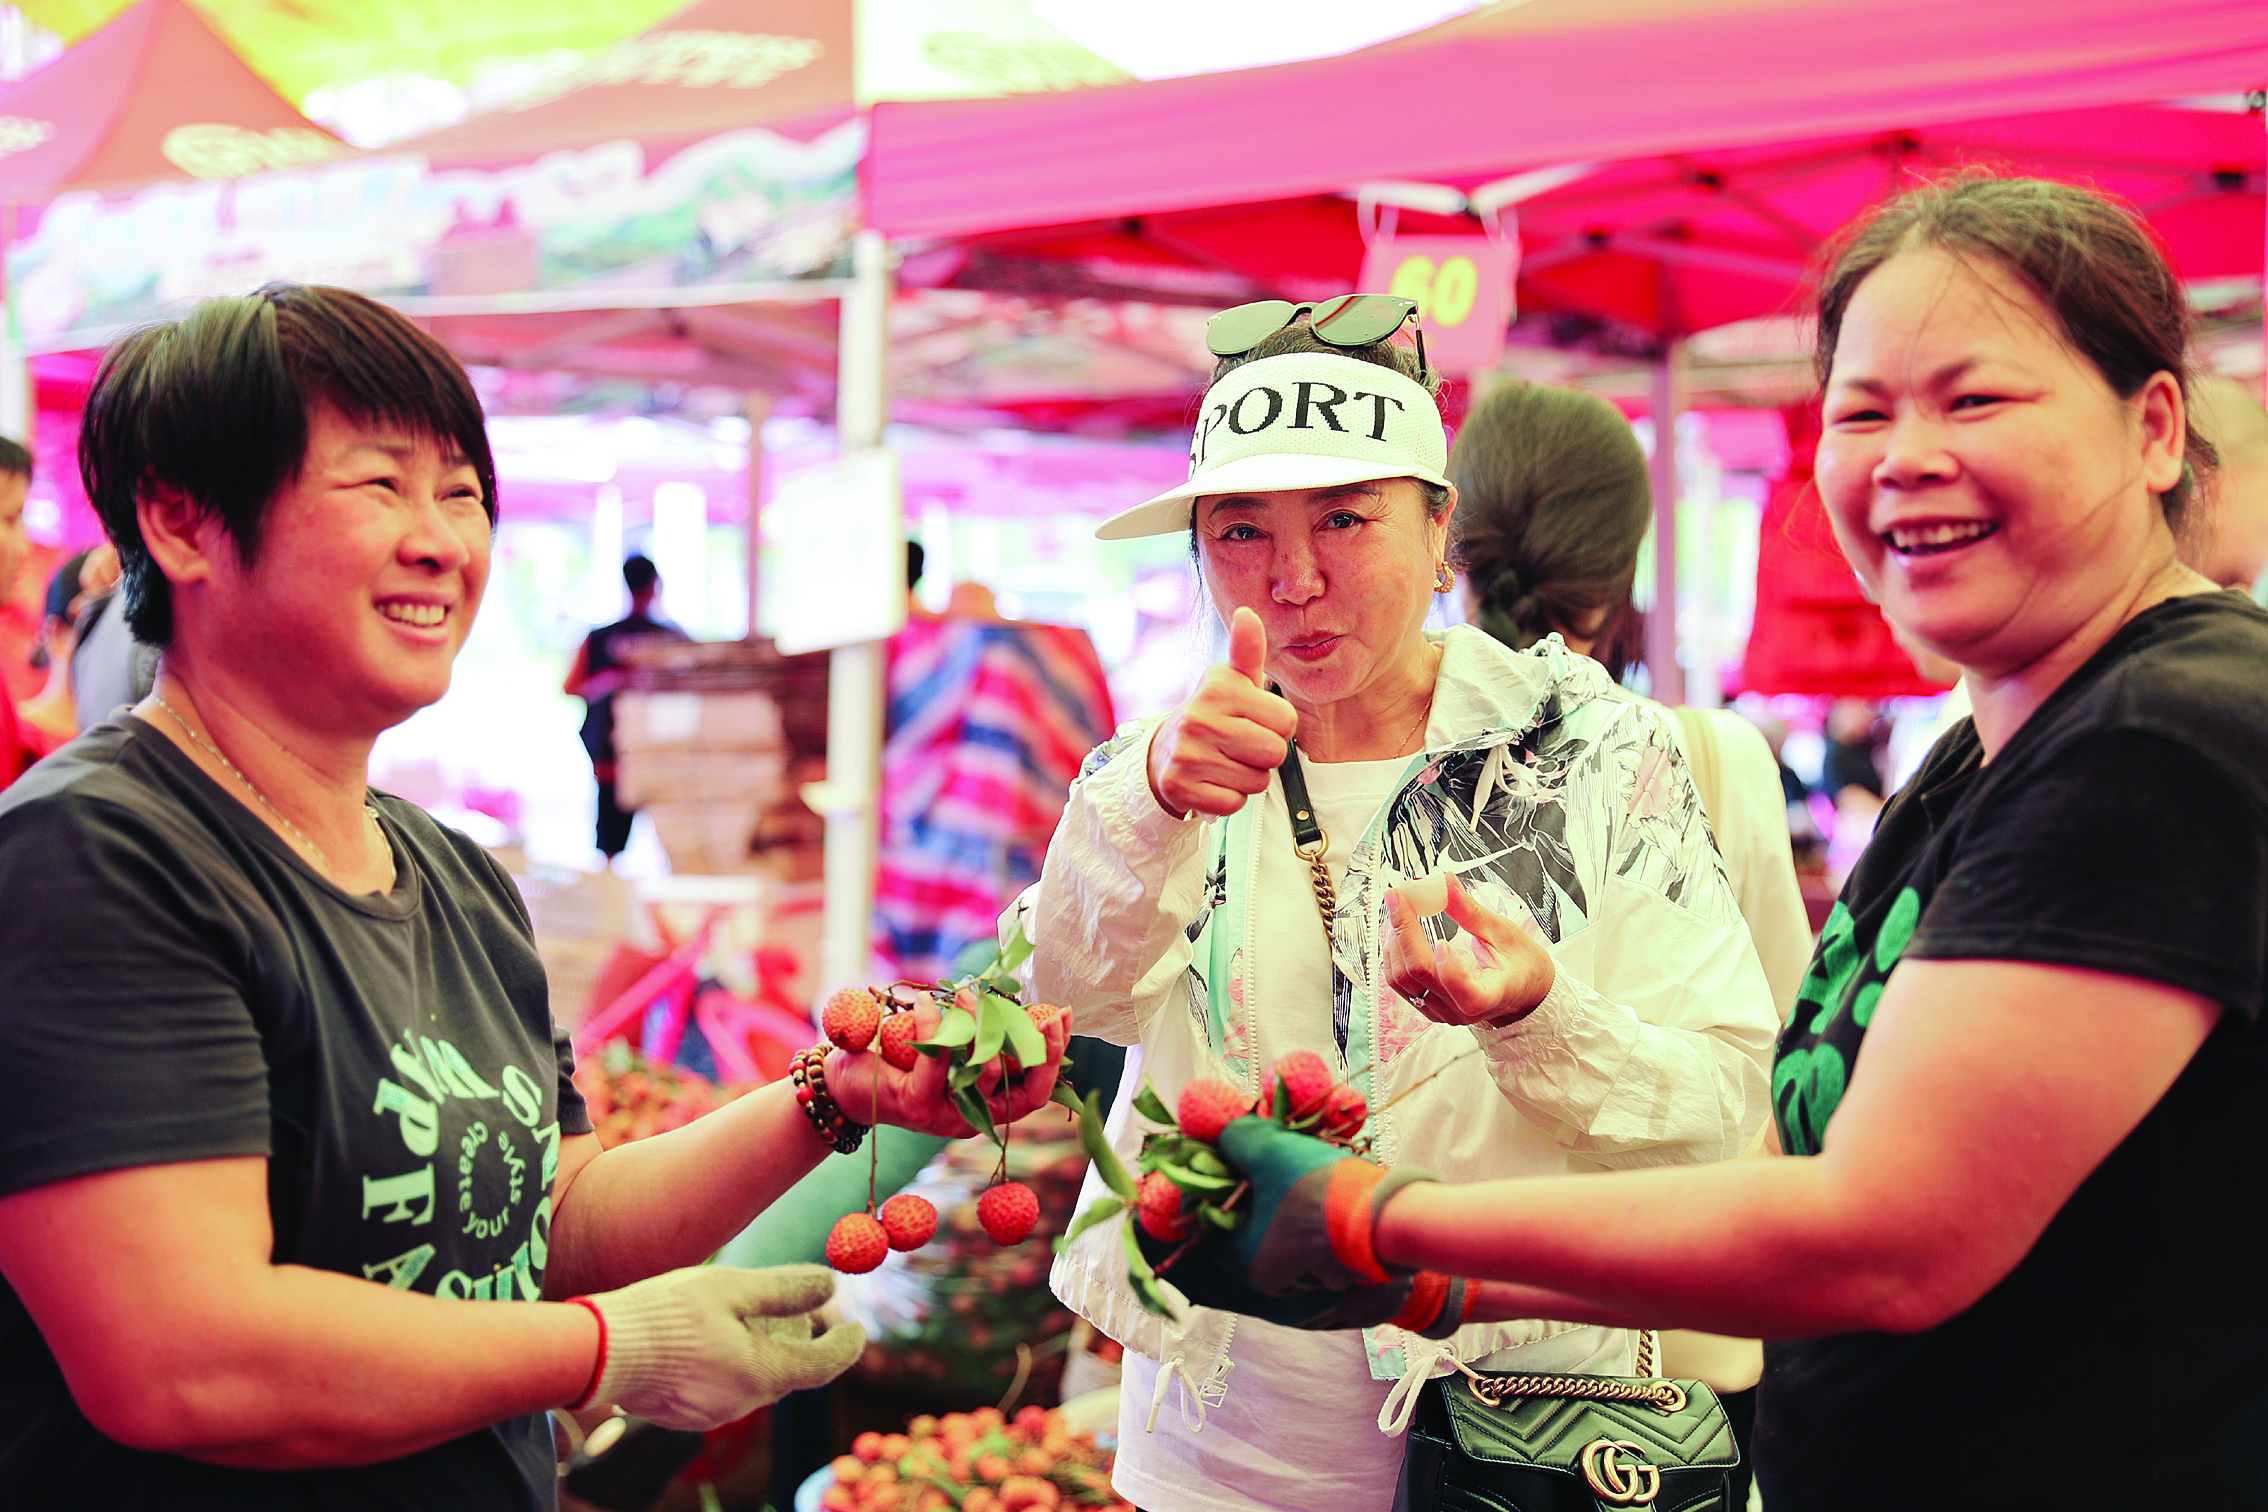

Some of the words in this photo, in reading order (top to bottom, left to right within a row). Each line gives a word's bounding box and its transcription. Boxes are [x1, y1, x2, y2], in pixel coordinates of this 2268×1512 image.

[1389, 254, 1479, 328] 60
[458, 1121, 489, 1213] create
[498, 1130, 527, 1206] style
[462, 1205, 511, 1239] your
